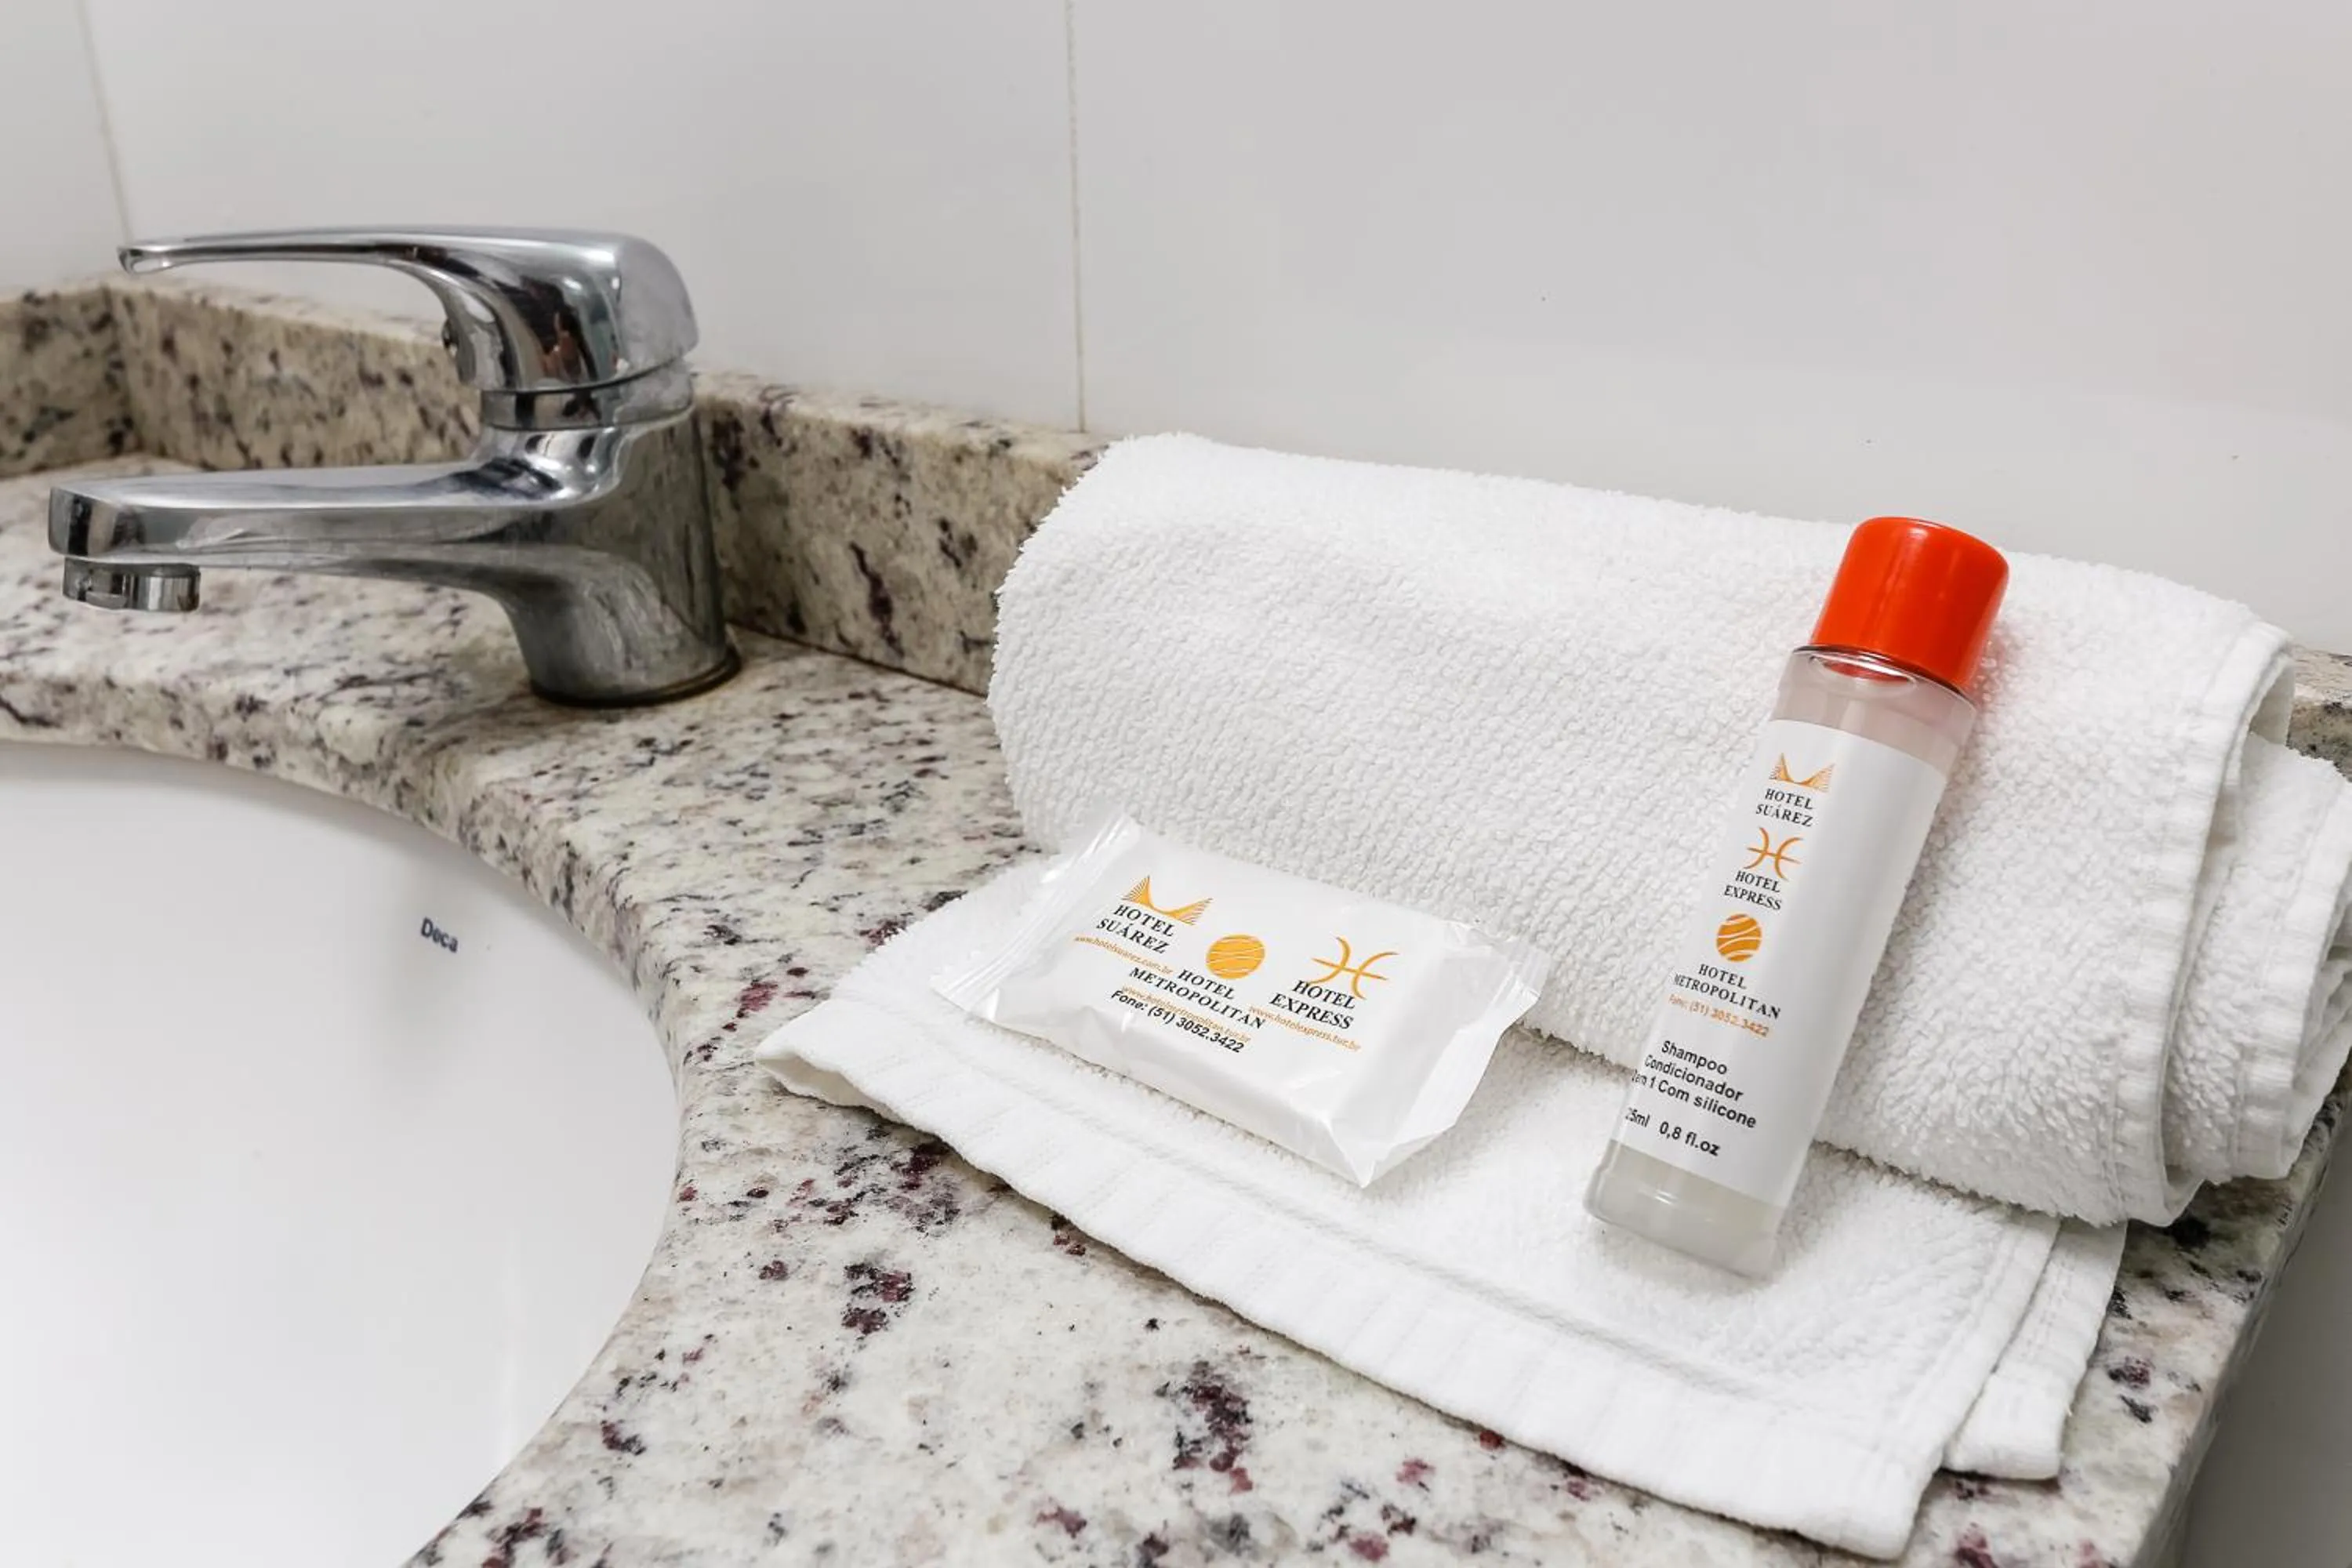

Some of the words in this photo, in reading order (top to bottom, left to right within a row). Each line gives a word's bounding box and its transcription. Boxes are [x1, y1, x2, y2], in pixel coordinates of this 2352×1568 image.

[1756, 804, 1813, 827] SUÁREZ
[1765, 788, 1813, 810] HOTEL
[1724, 885, 1782, 910] EXPRESS
[1735, 870, 1780, 892] HOTEL
[421, 916, 459, 954] Deca
[1096, 918, 1171, 954] SUÁREZ
[1113, 904, 1176, 937] HOTEL
[1177, 969, 1236, 1000] HOTEL
[1698, 964, 1748, 989] HOTEL
[1129, 967, 1266, 1029] METROPOLITAN
[1269, 993, 1354, 1029] EXPRESS
[1292, 980, 1356, 1010] HOTEL
[1674, 973, 1781, 1020] METROPOLITAN
[1111, 990, 1149, 1011] Fone:
[1148, 1005, 1175, 1024] (51)
[1176, 1017, 1245, 1053] 3052.3422
[1661, 1040, 1728, 1075] Shampoo
[1645, 1054, 1744, 1101] Condicionador
[1658, 1079, 1690, 1102] Com
[1693, 1095, 1757, 1128] silicone
[1660, 1121, 1682, 1141] 0,8
[1685, 1131, 1721, 1156] fl.oz
